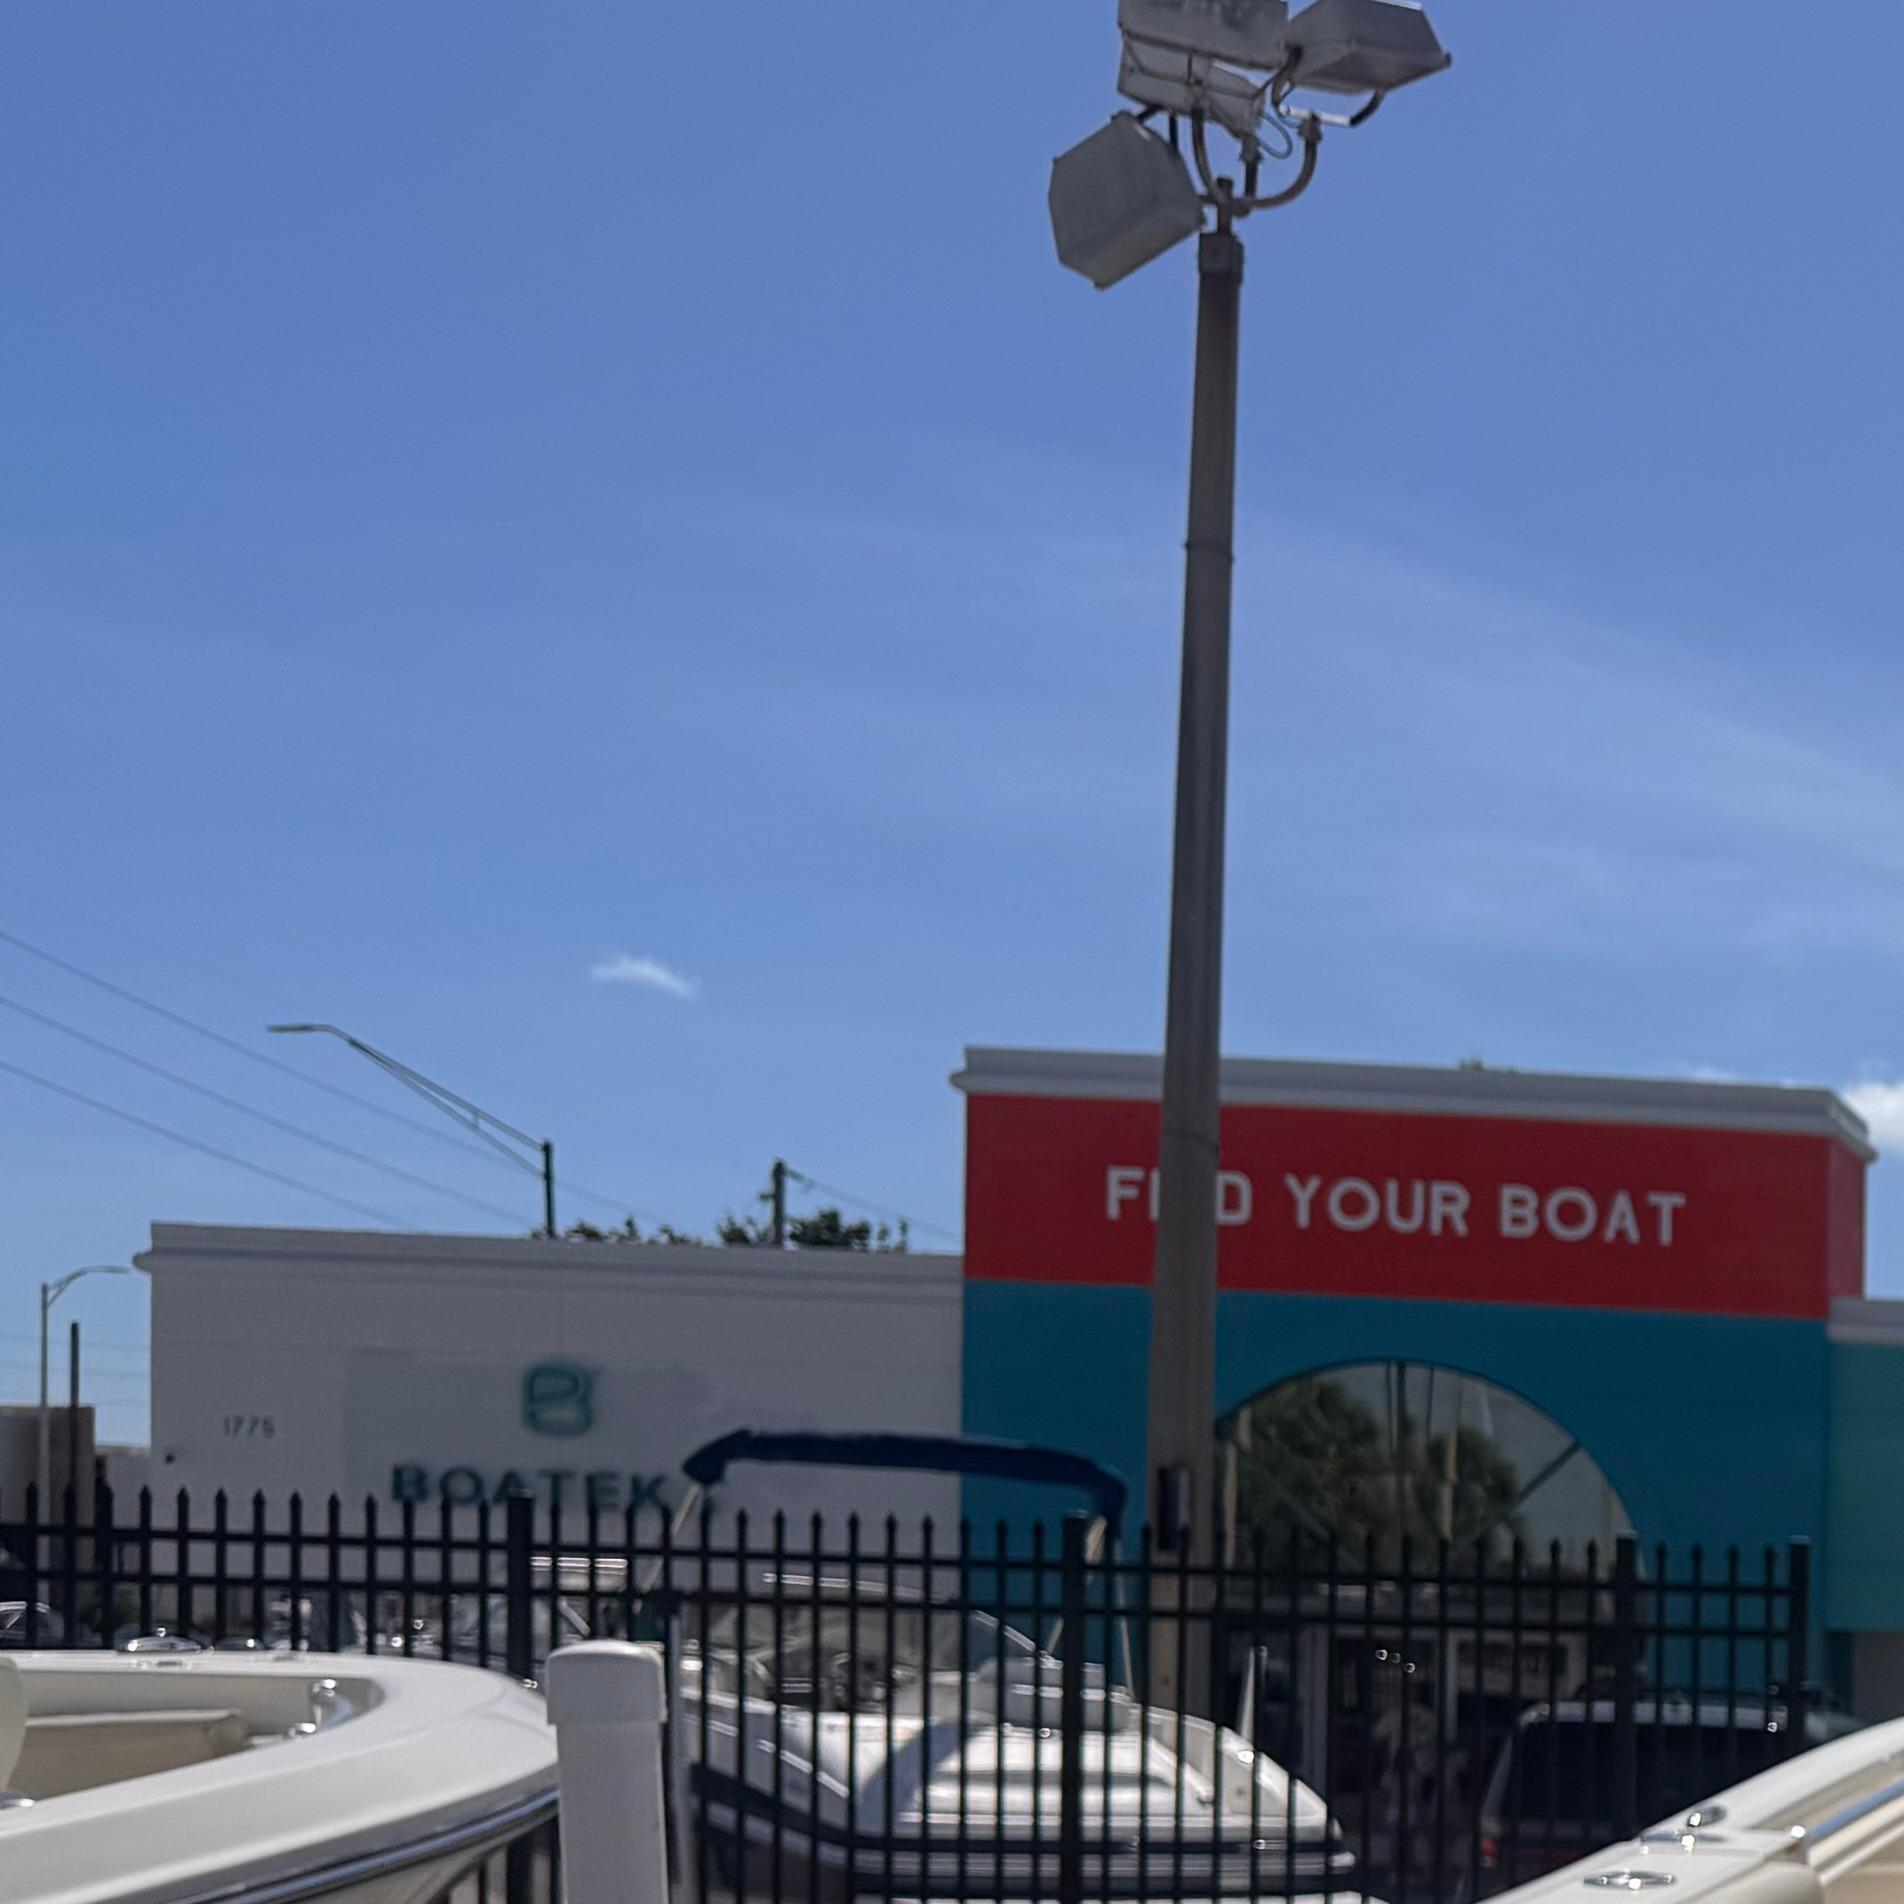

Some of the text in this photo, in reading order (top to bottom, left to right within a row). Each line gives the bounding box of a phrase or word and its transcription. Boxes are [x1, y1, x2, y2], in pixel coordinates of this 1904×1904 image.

[1106, 1165, 1687, 1247] FID YOUR BOAT
[391, 1464, 670, 1510] BOATEK
